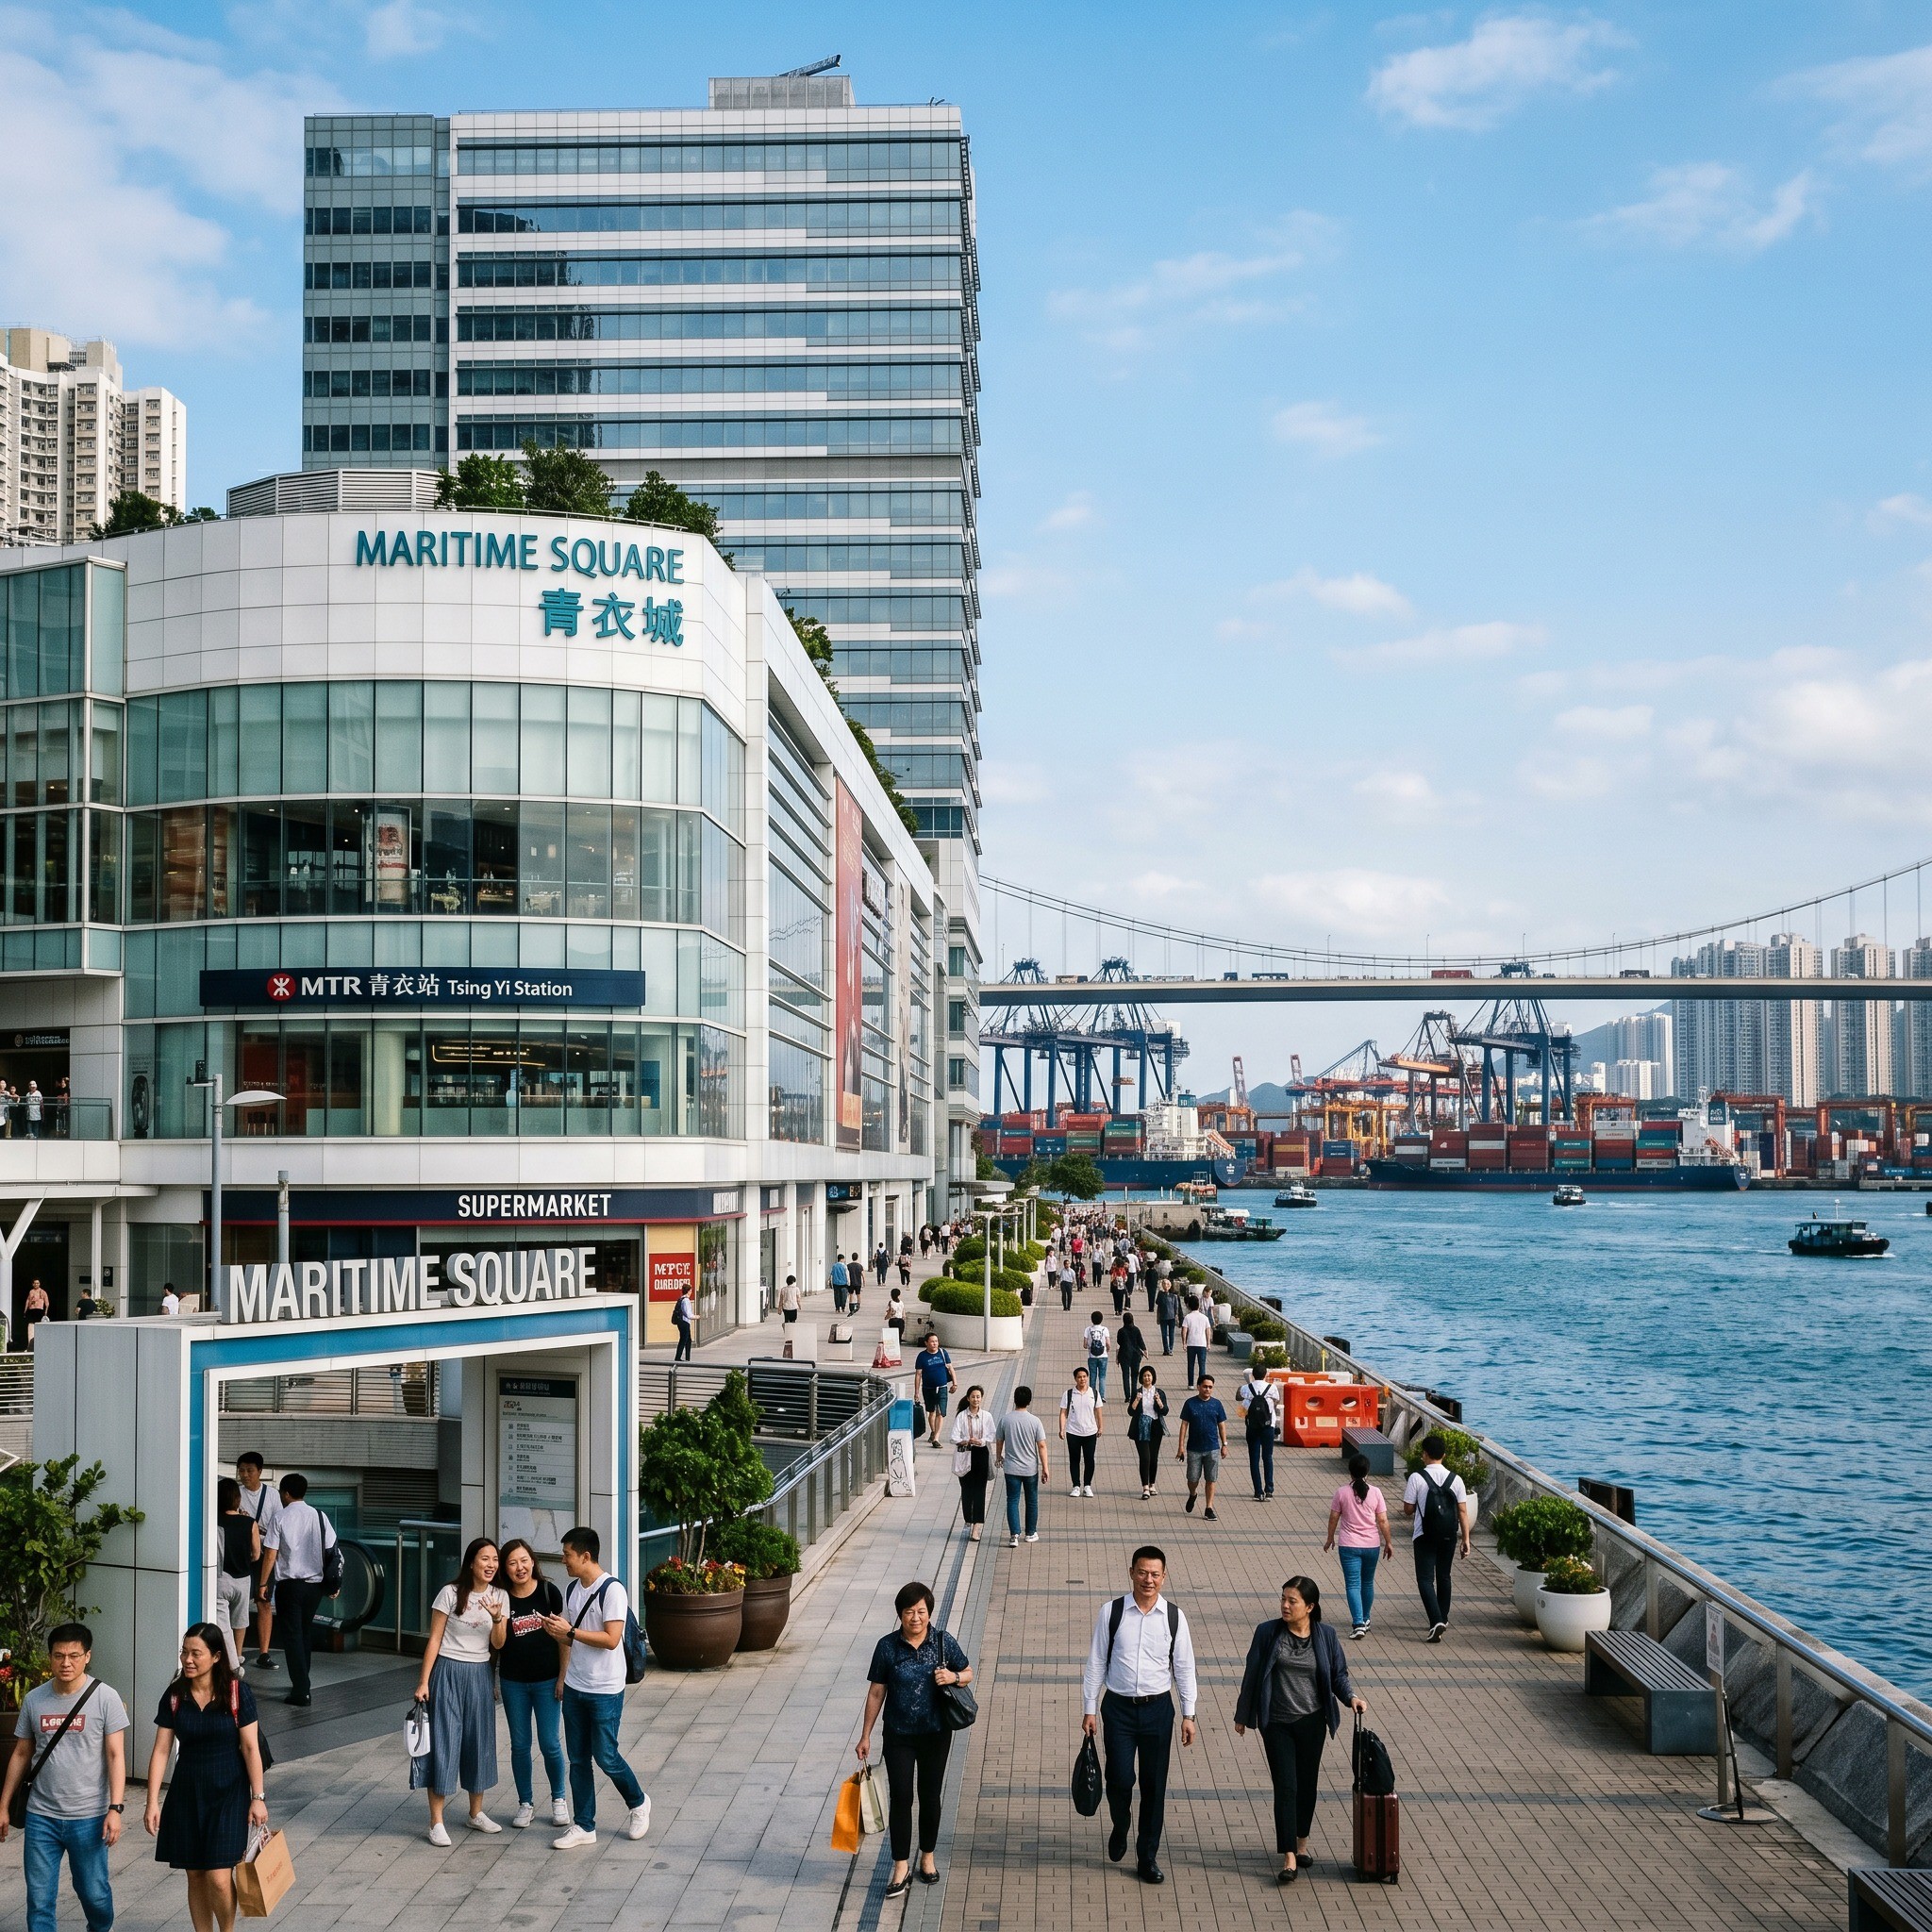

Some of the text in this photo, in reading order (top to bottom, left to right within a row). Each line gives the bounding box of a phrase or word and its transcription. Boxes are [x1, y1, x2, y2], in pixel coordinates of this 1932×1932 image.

[356, 530, 685, 584] MARITIME SQUARE
[539, 587, 685, 647] 青衣城
[301, 973, 573, 999] MTR 青衣站 Tsing Yi Station
[458, 1193, 611, 1218] SUPERMARKET
[227, 1246, 597, 1324] MARITIME SQUARE
